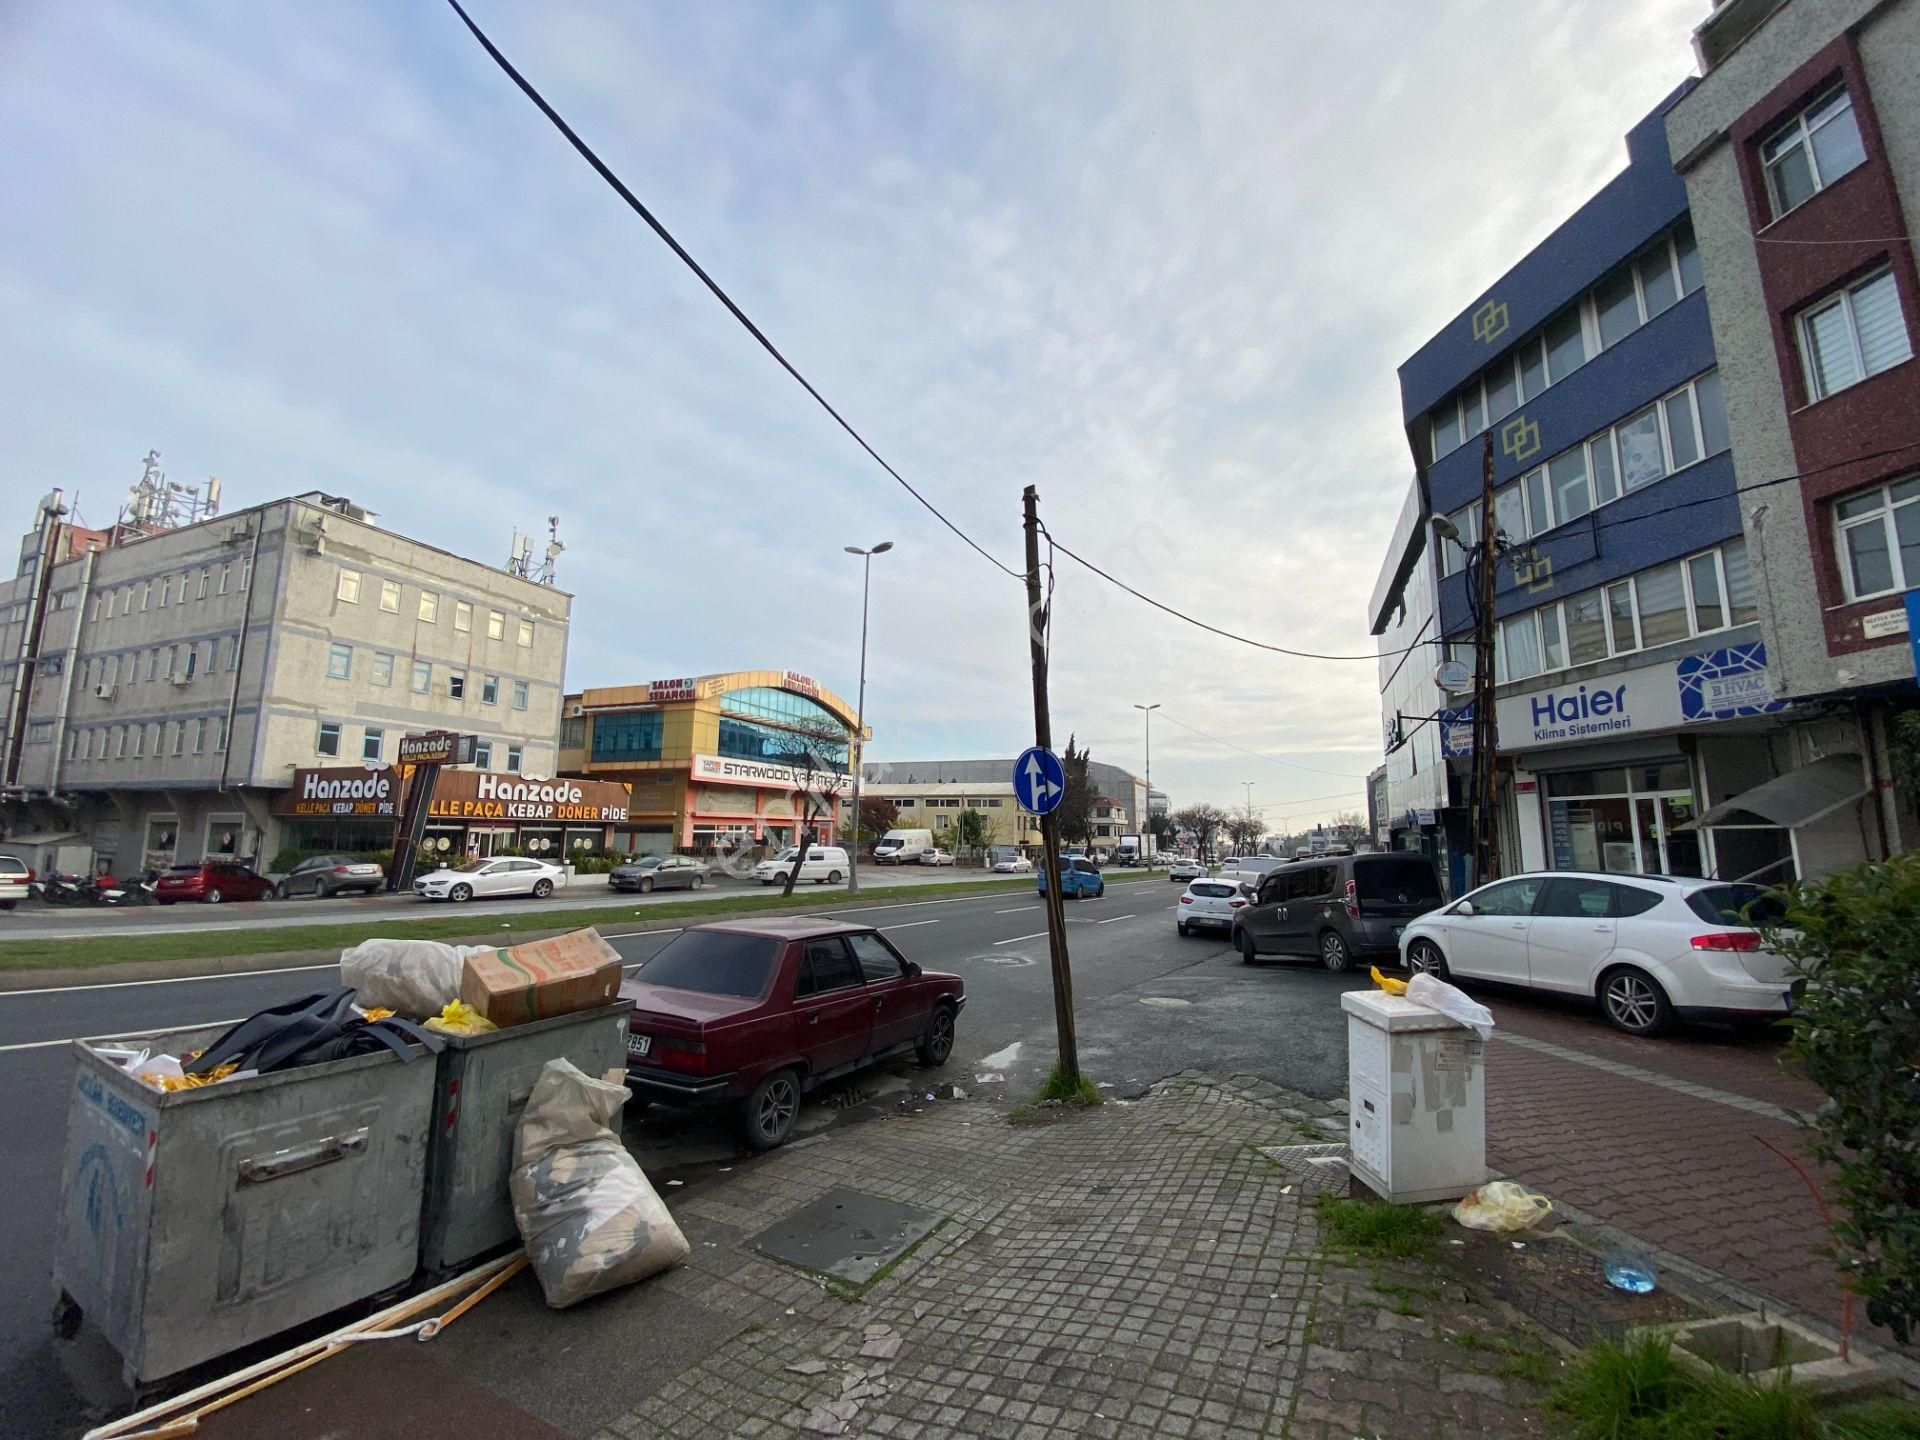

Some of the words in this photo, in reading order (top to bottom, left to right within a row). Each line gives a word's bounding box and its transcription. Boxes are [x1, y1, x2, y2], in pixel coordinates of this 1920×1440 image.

[652, 679, 682, 690] SALON
[1725, 677, 1765, 695] HVAC
[1530, 684, 1627, 727] Haier
[1534, 726, 1566, 742] Klima
[1568, 715, 1632, 737] Sistemleri
[401, 736, 452, 754] Hanzade
[723, 763, 791, 781] STARWOOD
[304, 771, 390, 800] Hanzade
[478, 774, 583, 804] Hanzade
[296, 803, 313, 814] KELLE
[332, 802, 354, 814] KEBAP
[378, 800, 394, 814] PİDE
[428, 800, 460, 816] LLE
[463, 800, 504, 817] PAÇA
[507, 804, 554, 819] KEBAP
[557, 802, 598, 820] DÖNER
[601, 804, 627, 821] PİDE
[627, 1034, 650, 1052] 2851
